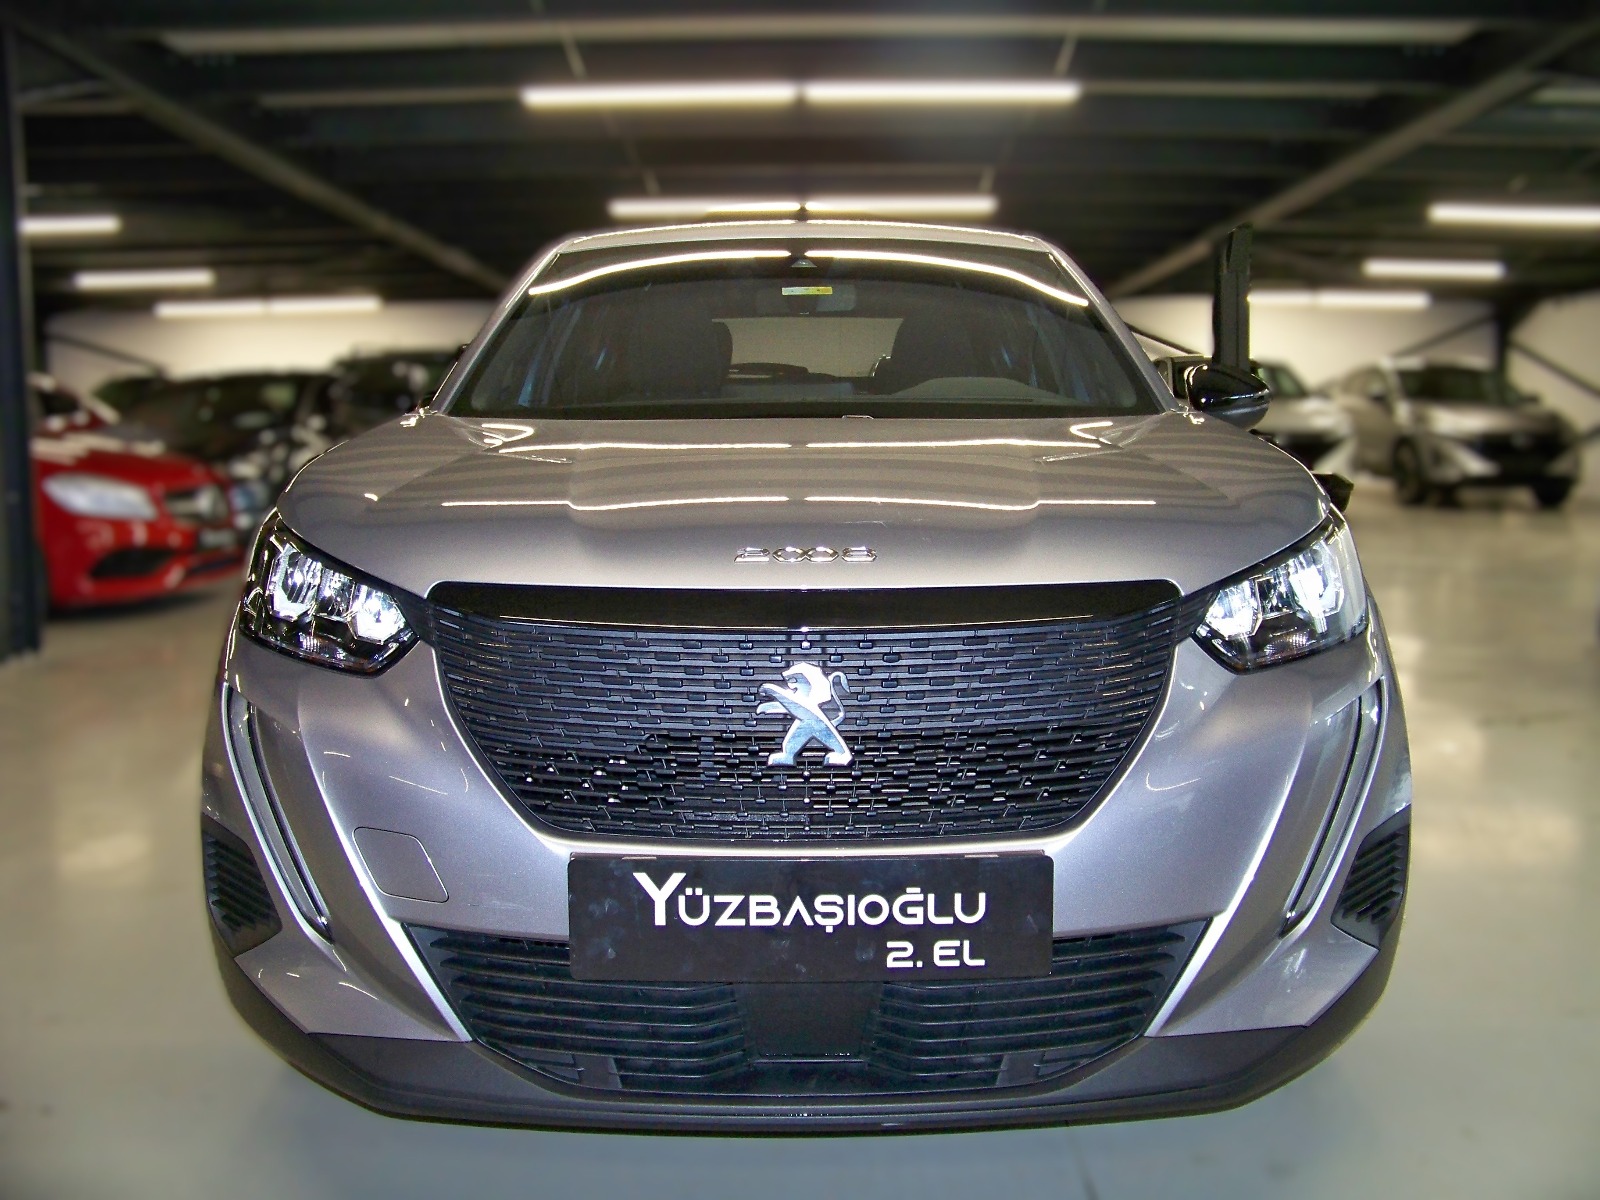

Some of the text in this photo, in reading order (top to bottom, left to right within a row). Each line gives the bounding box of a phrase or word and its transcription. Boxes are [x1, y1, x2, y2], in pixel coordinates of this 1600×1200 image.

[734, 546, 877, 563] 2008
[632, 871, 987, 933] YÜZBAŞIOĞLU
[886, 940, 986, 968] 2. EL
